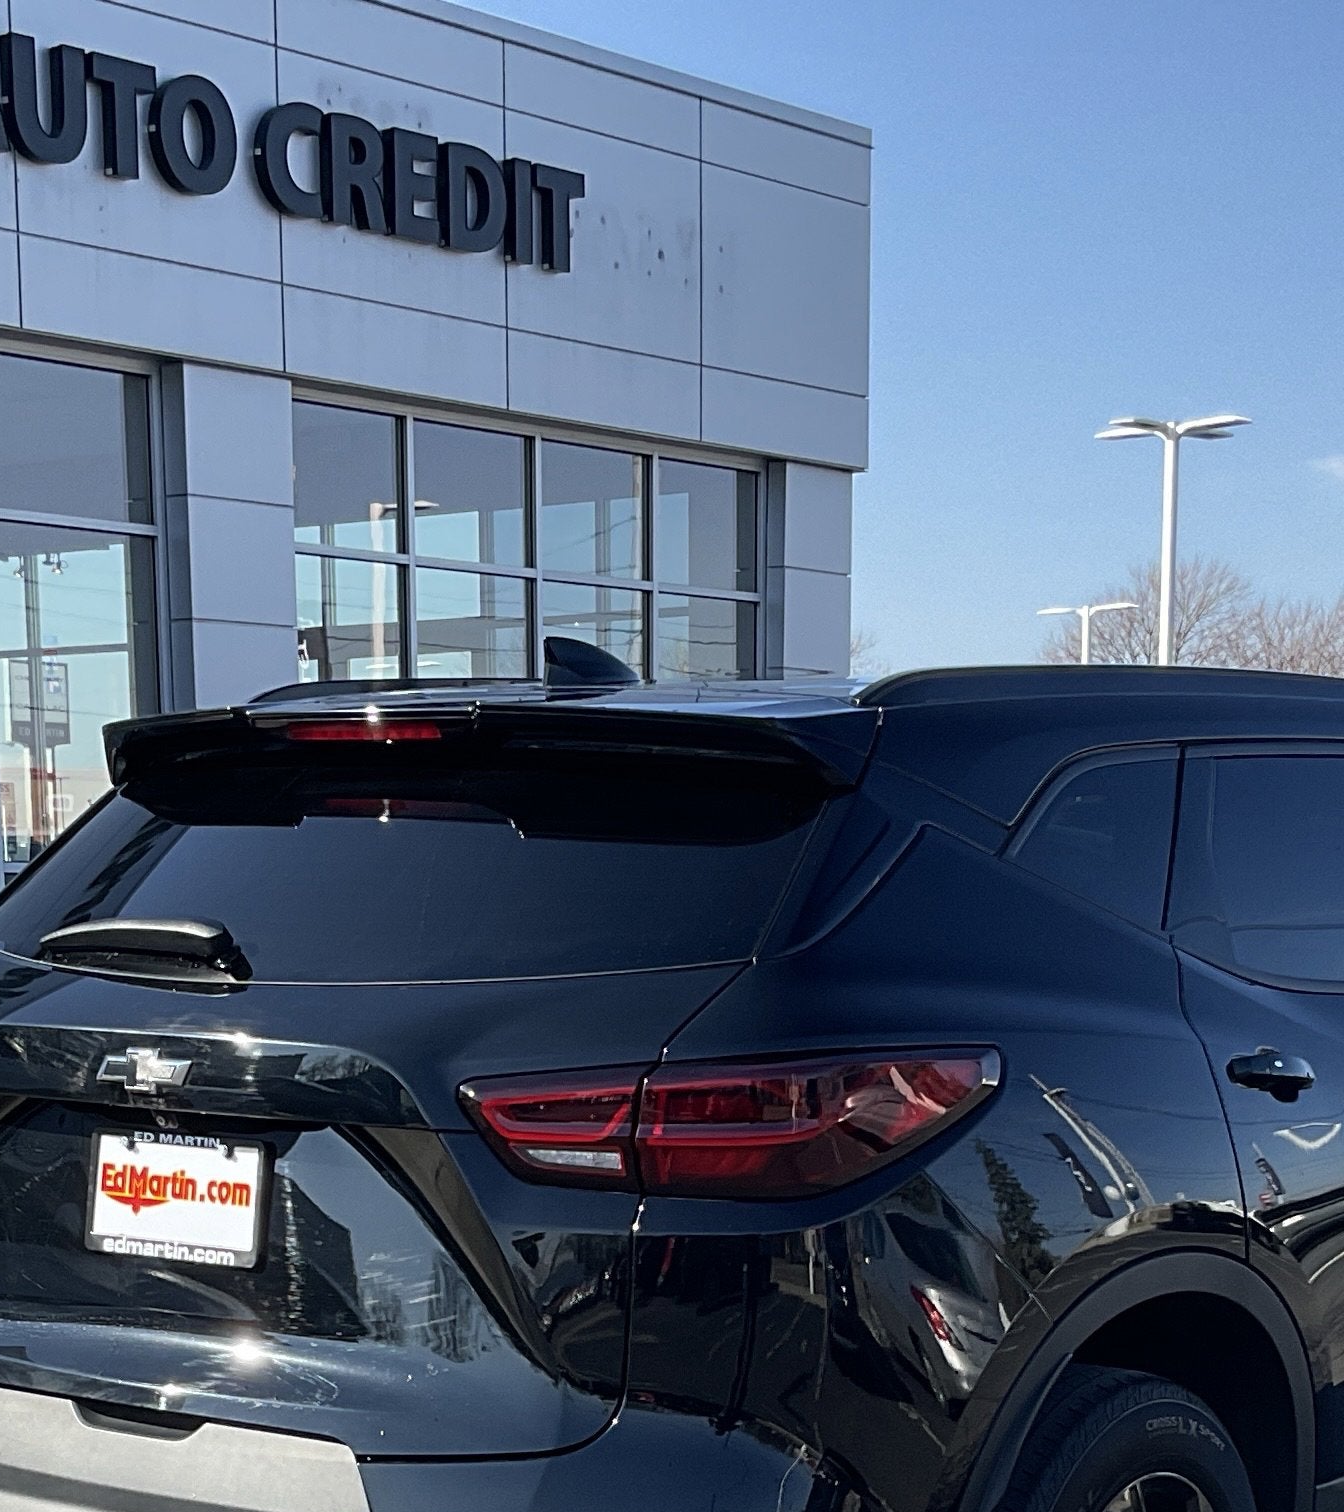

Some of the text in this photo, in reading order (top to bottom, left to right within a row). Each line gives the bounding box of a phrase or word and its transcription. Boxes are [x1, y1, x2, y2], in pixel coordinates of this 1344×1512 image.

[254, 102, 586, 274] CREDIT
[133, 1130, 221, 1149] ED MARTIN
[101, 1162, 252, 1208] EdMartin.com
[103, 1233, 235, 1267] edmartin.com
